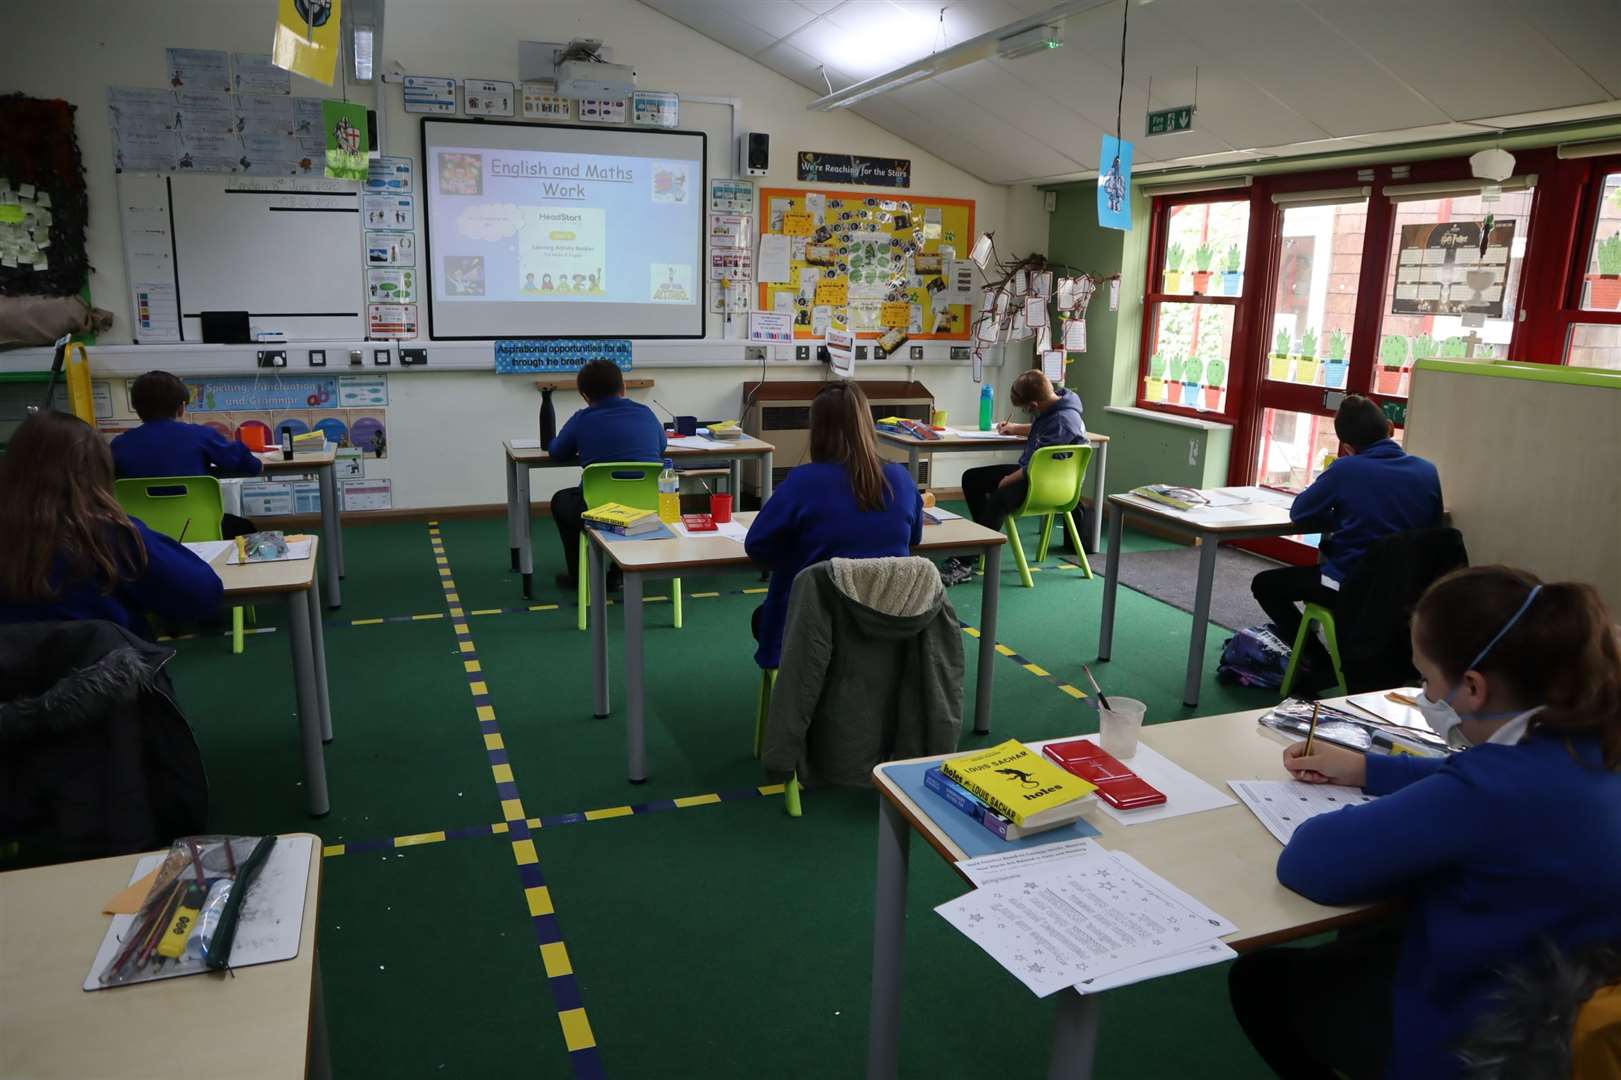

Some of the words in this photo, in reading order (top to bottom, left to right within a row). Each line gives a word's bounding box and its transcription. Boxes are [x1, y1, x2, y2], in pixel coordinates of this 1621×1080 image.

[491, 159, 547, 178] English
[553, 163, 579, 177] and
[586, 164, 633, 180] Maths
[801, 162, 823, 171] We're
[825, 164, 860, 175] Reaching
[860, 165, 872, 177] for
[873, 166, 886, 176] the
[887, 168, 907, 178] Stars
[542, 182, 586, 197] Work
[538, 212, 582, 222] HeadStart
[498, 344, 548, 355] Aspirational
[548, 344, 602, 356] opportunities
[604, 344, 616, 353] for
[512, 357, 544, 367] through
[254, 383, 316, 393] Punctuation
[225, 397, 246, 406] and
[964, 763, 991, 774] LOUIS
[991, 751, 1029, 767] SACHAR
[943, 763, 963, 784] holes
[971, 783, 991, 802] LOUIS
[989, 796, 1017, 819] SACHAR
[1023, 783, 1063, 801] holes
